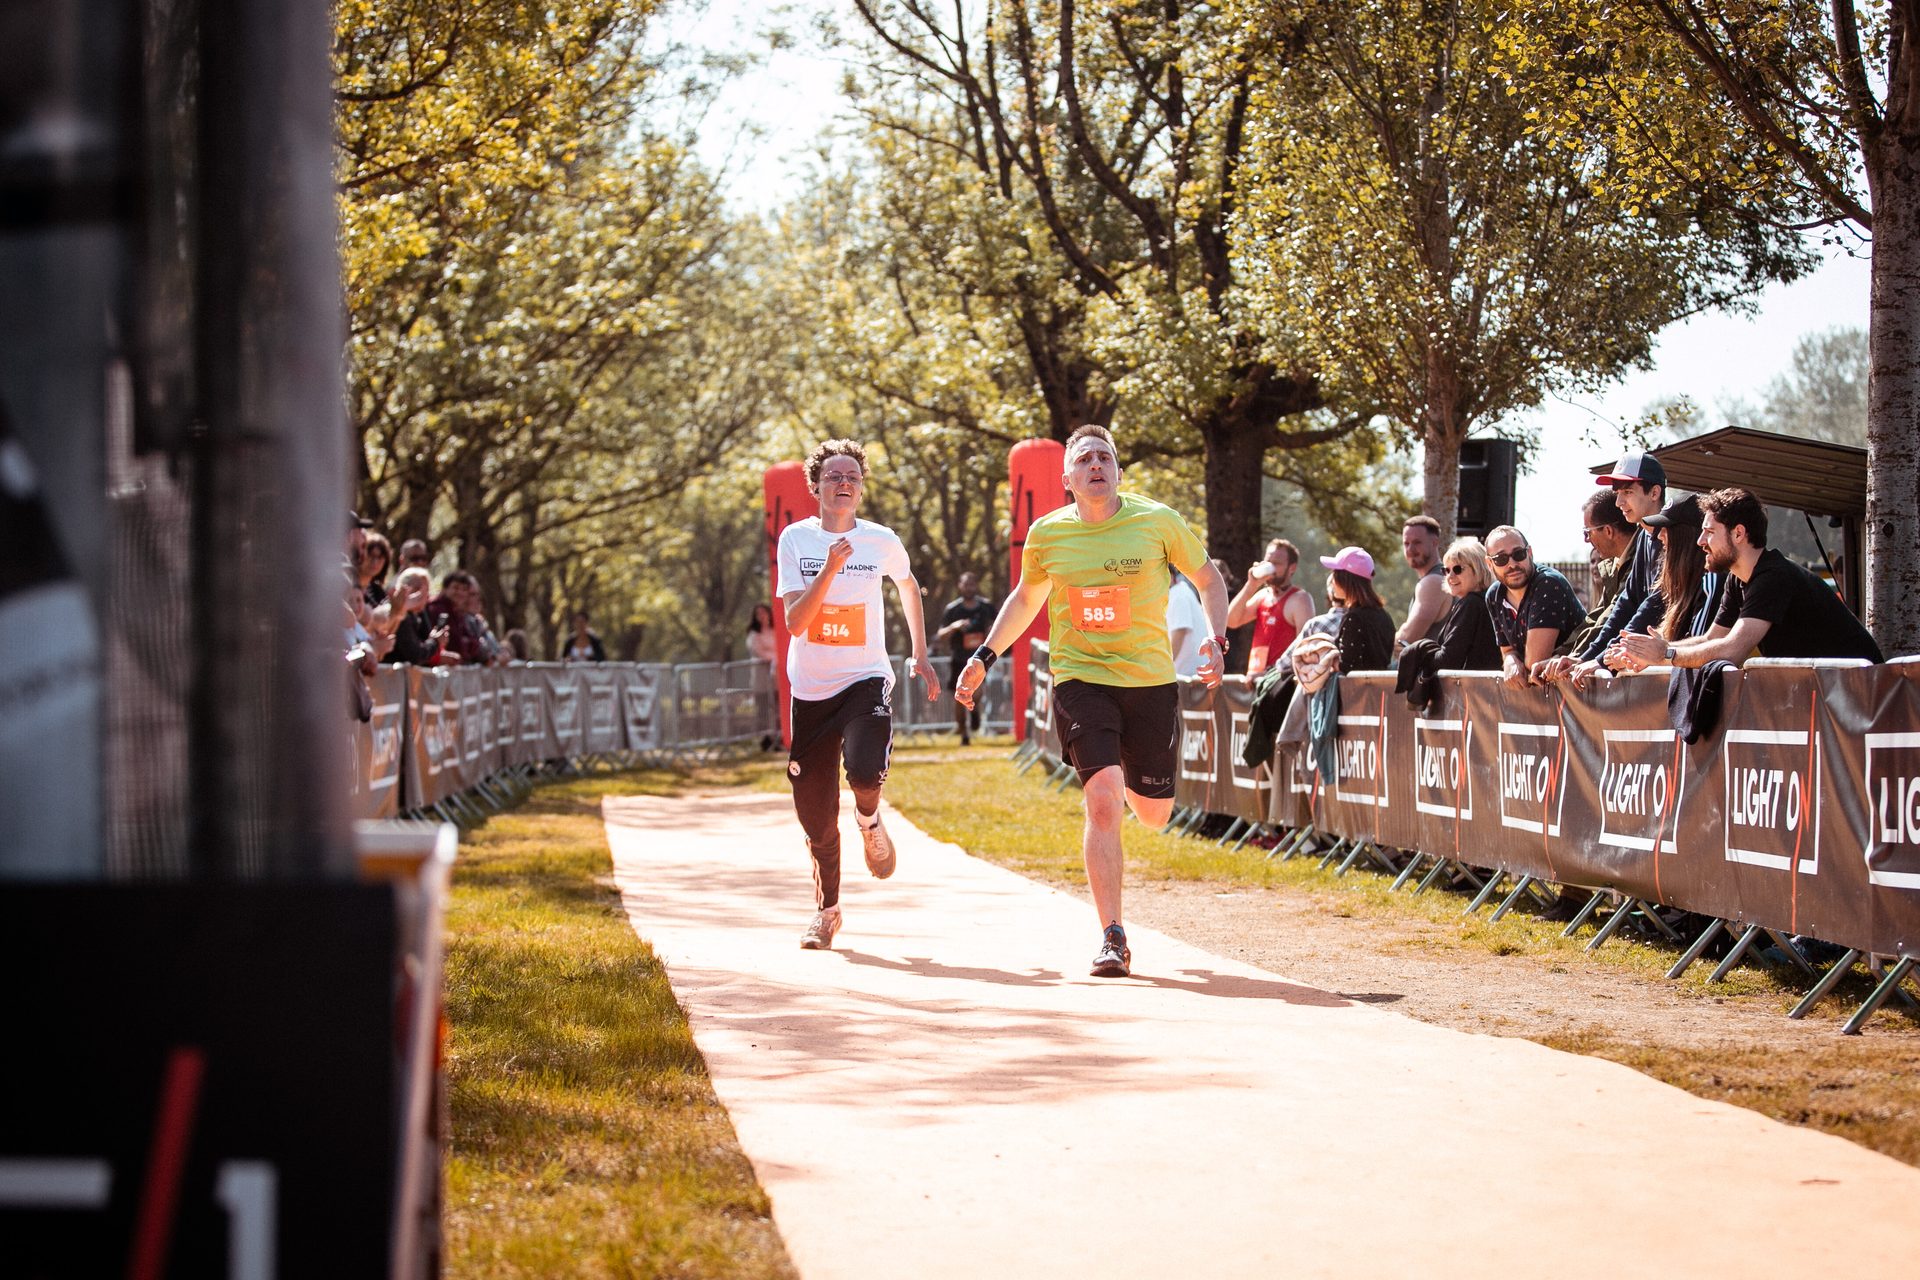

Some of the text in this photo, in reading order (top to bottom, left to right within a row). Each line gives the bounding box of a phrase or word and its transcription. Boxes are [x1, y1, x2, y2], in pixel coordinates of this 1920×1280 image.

[803, 561, 825, 569] LIGH
[822, 623, 850, 637] 514
[1083, 607, 1115, 622] 585
[1339, 739, 1365, 779] LIGHT
[1418, 744, 1447, 790] LIGHT
[1503, 752, 1536, 802] LIGHT
[1141, 775, 1171, 785] BLK
[1606, 762, 1651, 816] LIGHT
[1733, 767, 1784, 829] LIGHT
